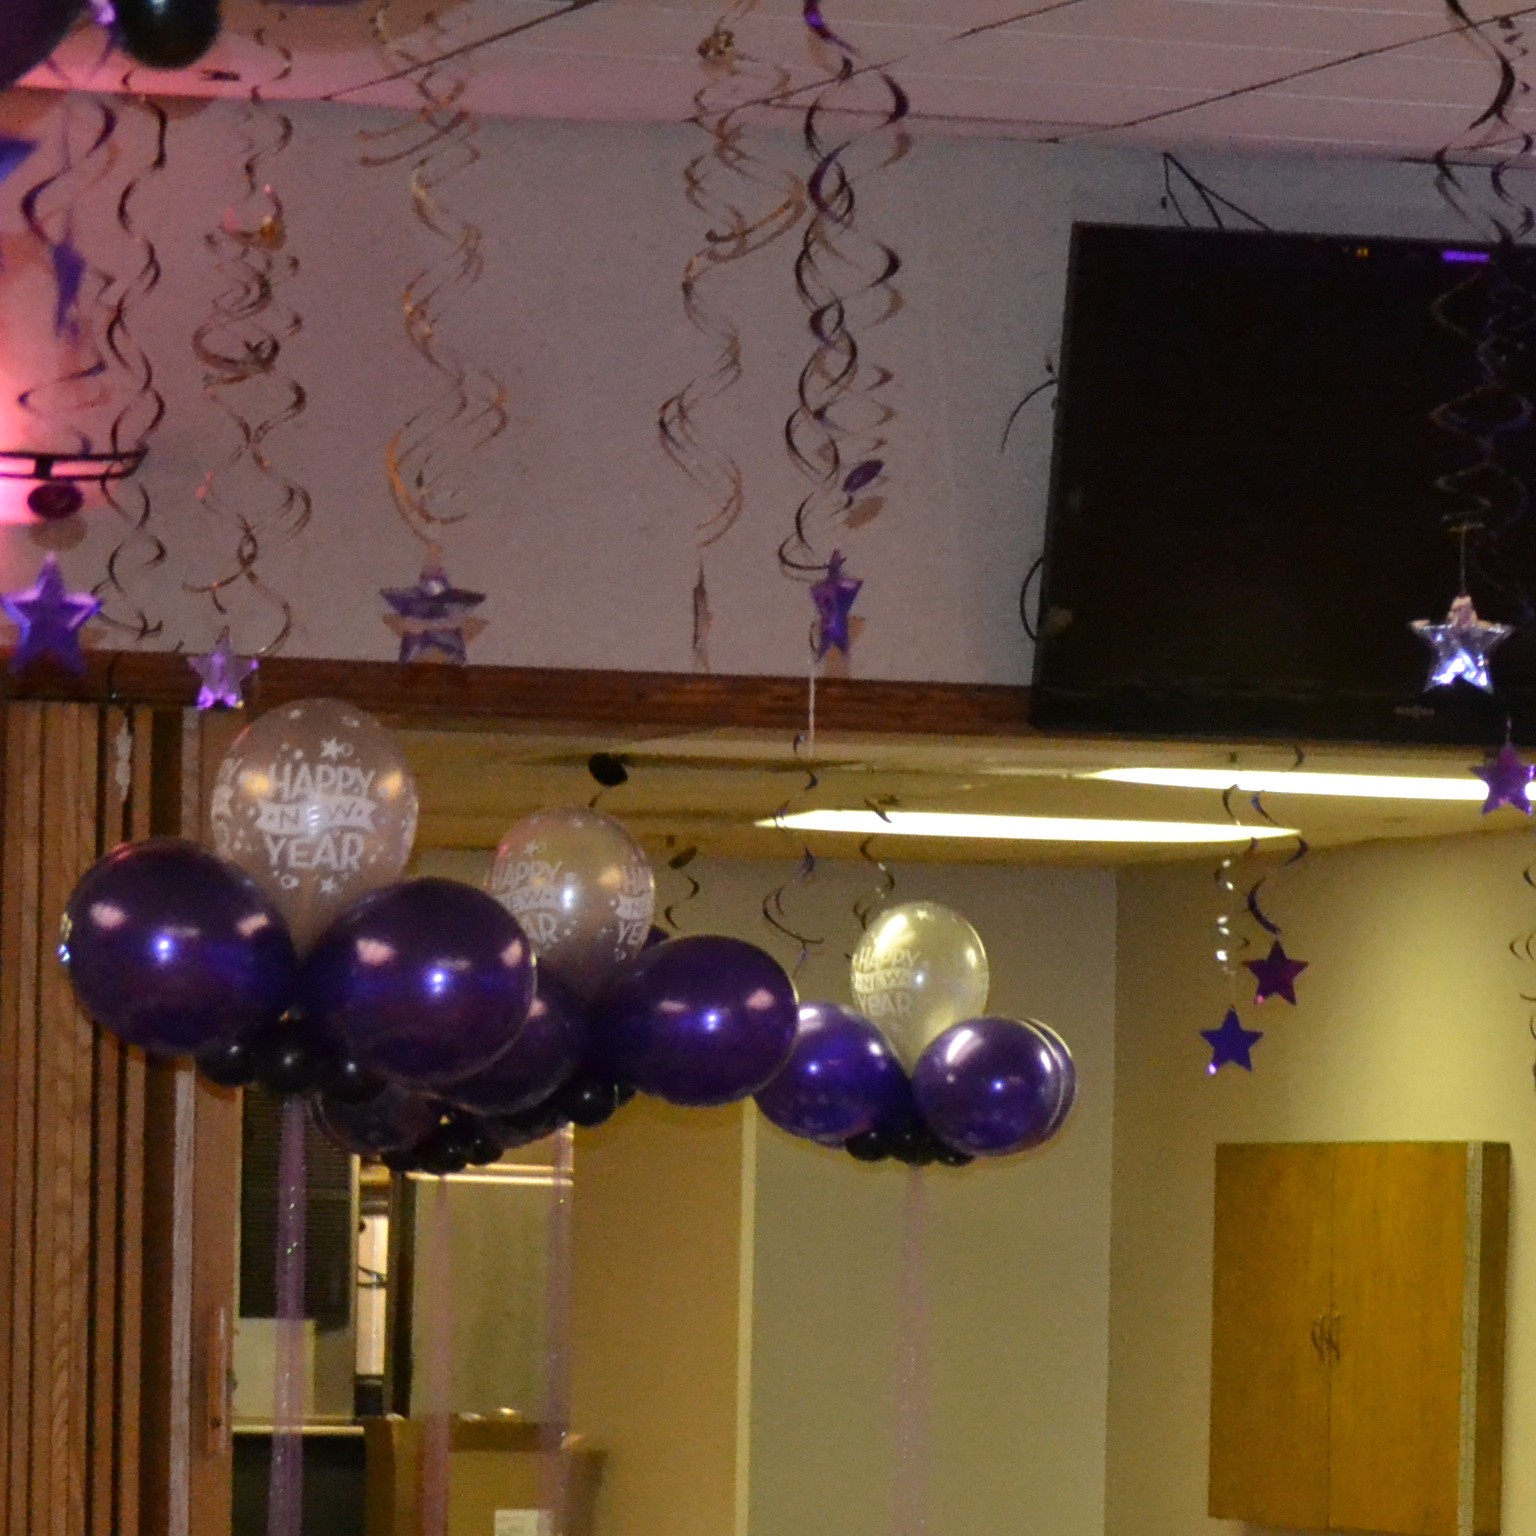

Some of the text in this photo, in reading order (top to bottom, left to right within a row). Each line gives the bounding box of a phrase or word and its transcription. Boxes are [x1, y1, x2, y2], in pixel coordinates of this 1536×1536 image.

[268, 762, 376, 801] HAPPY
[279, 801, 356, 830] NEW
[263, 832, 364, 872] YEAR
